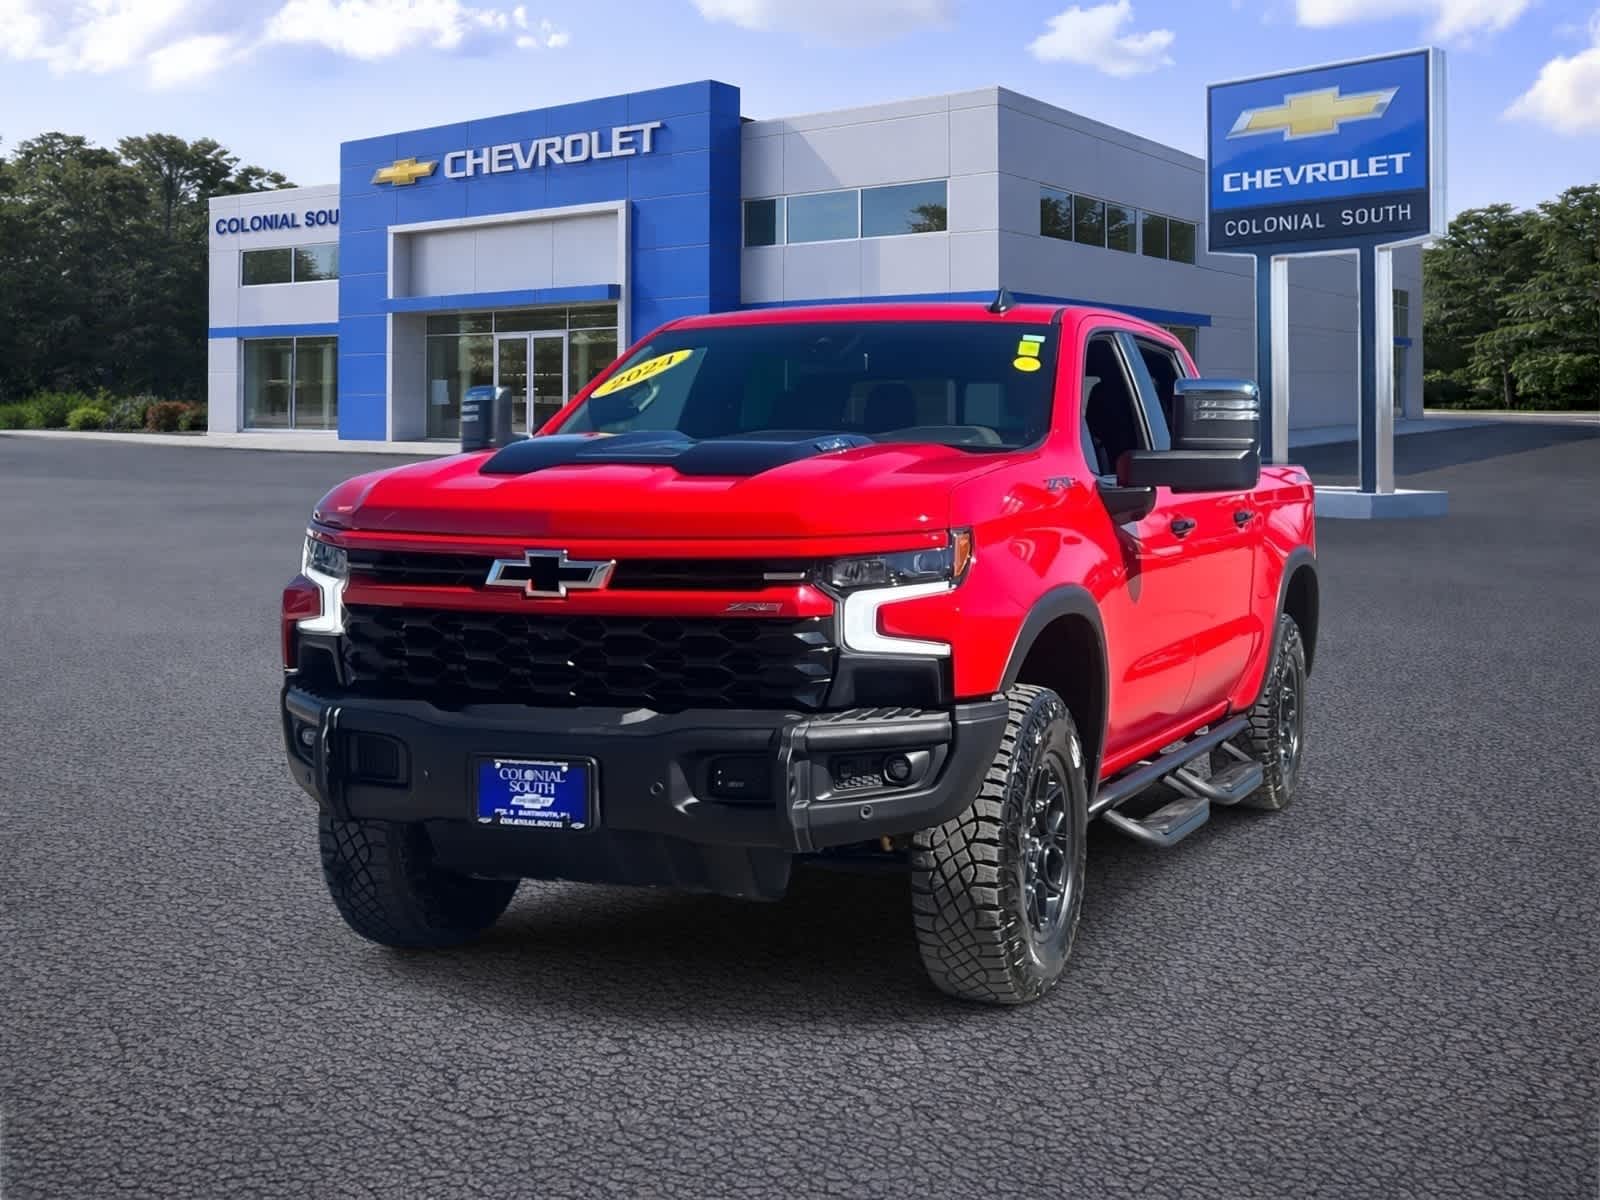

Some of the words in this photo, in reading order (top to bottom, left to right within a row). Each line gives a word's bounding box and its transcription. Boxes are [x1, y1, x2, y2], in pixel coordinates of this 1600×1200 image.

[444, 121, 661, 178] CHEVROLET
[1223, 152, 1411, 192] CHEVROLET
[215, 212, 301, 235] COLONIAL
[304, 208, 340, 228] SOU
[1224, 212, 1326, 237] COLONIAL
[1341, 203, 1413, 227] SOUTH
[610, 354, 675, 391] 2024
[499, 767, 566, 782] COLONIAL
[509, 780, 555, 794] SOUTH
